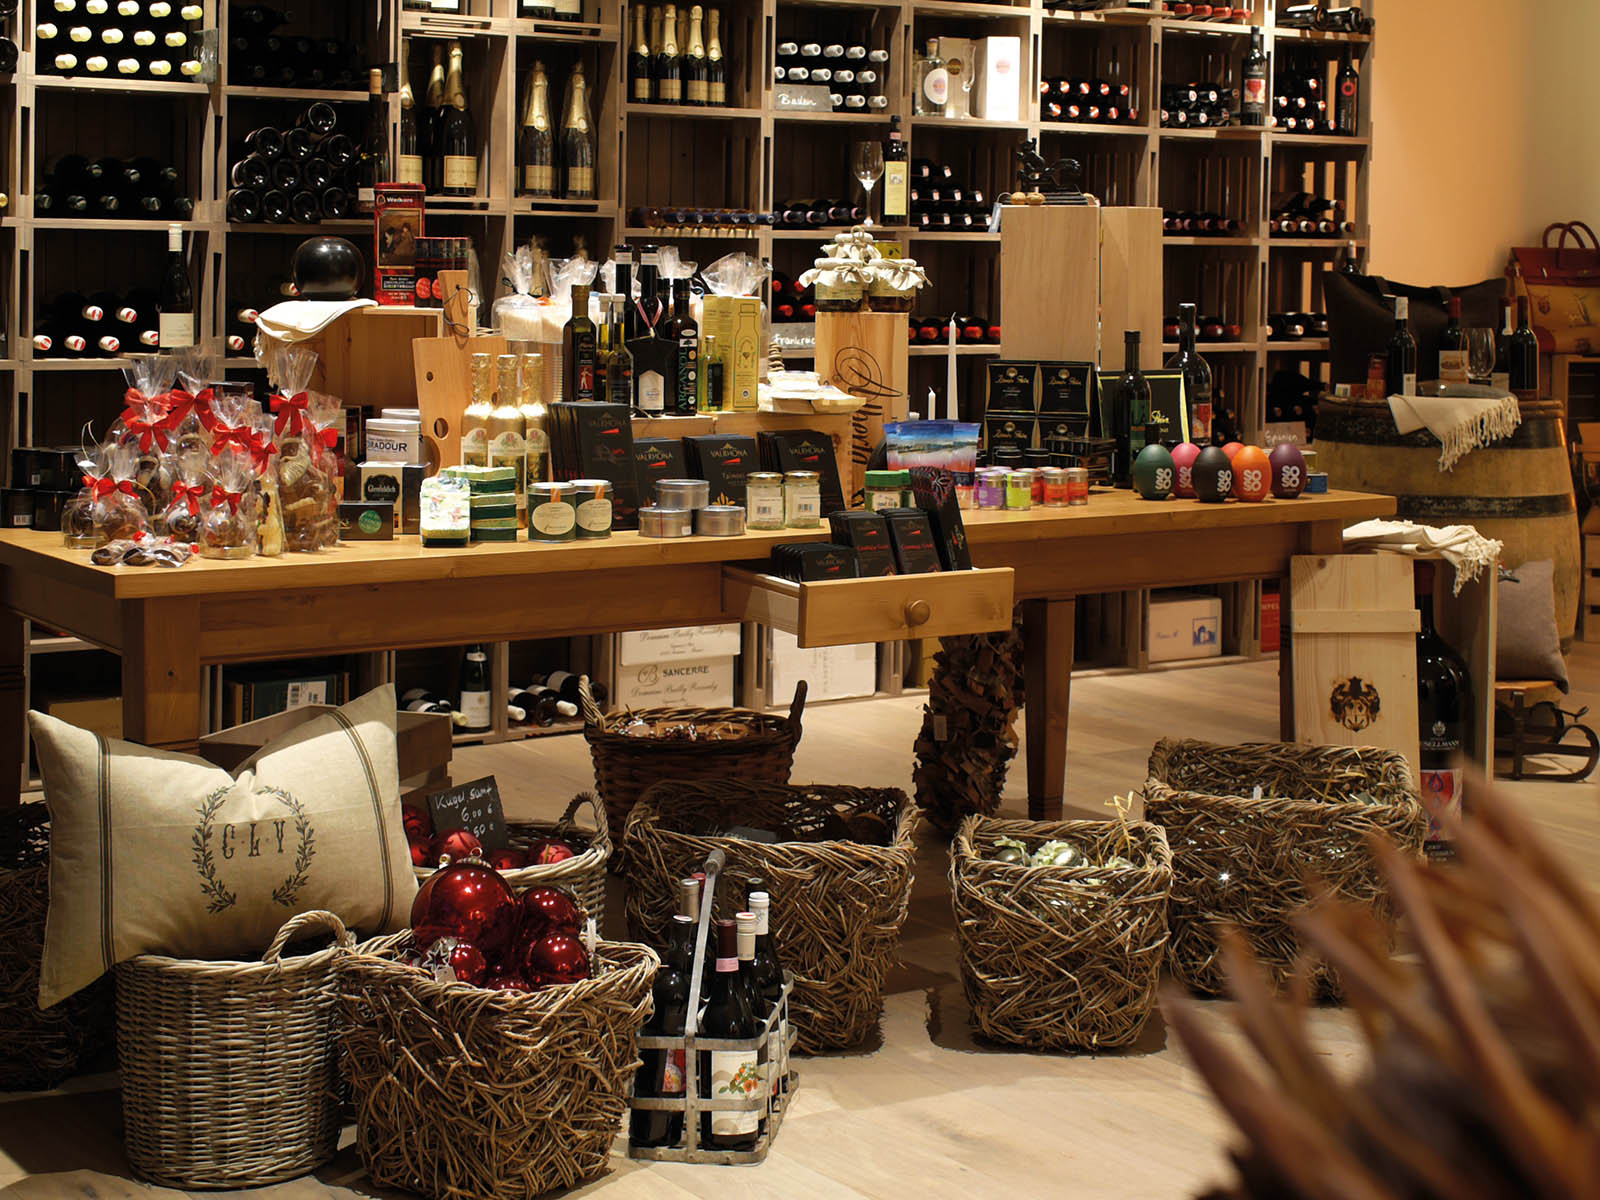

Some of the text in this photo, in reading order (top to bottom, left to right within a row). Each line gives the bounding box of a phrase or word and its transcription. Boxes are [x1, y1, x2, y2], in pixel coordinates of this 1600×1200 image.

[773, 333, 815, 345] Frankreic
[635, 452, 673, 462] VALRHONA
[710, 449, 748, 459] VALRHONA
[788, 446, 825, 456] VALRHONA
[1155, 468, 1172, 480] SO
[1217, 470, 1232, 482] SO
[1243, 469, 1262, 481] SO
[1282, 465, 1300, 477] SO
[1155, 479, 1172, 490] SO
[1217, 481, 1231, 492] SO
[1243, 480, 1262, 492] SO
[1282, 475, 1299, 488] SO
[662, 665, 710, 678] SANCERRE
